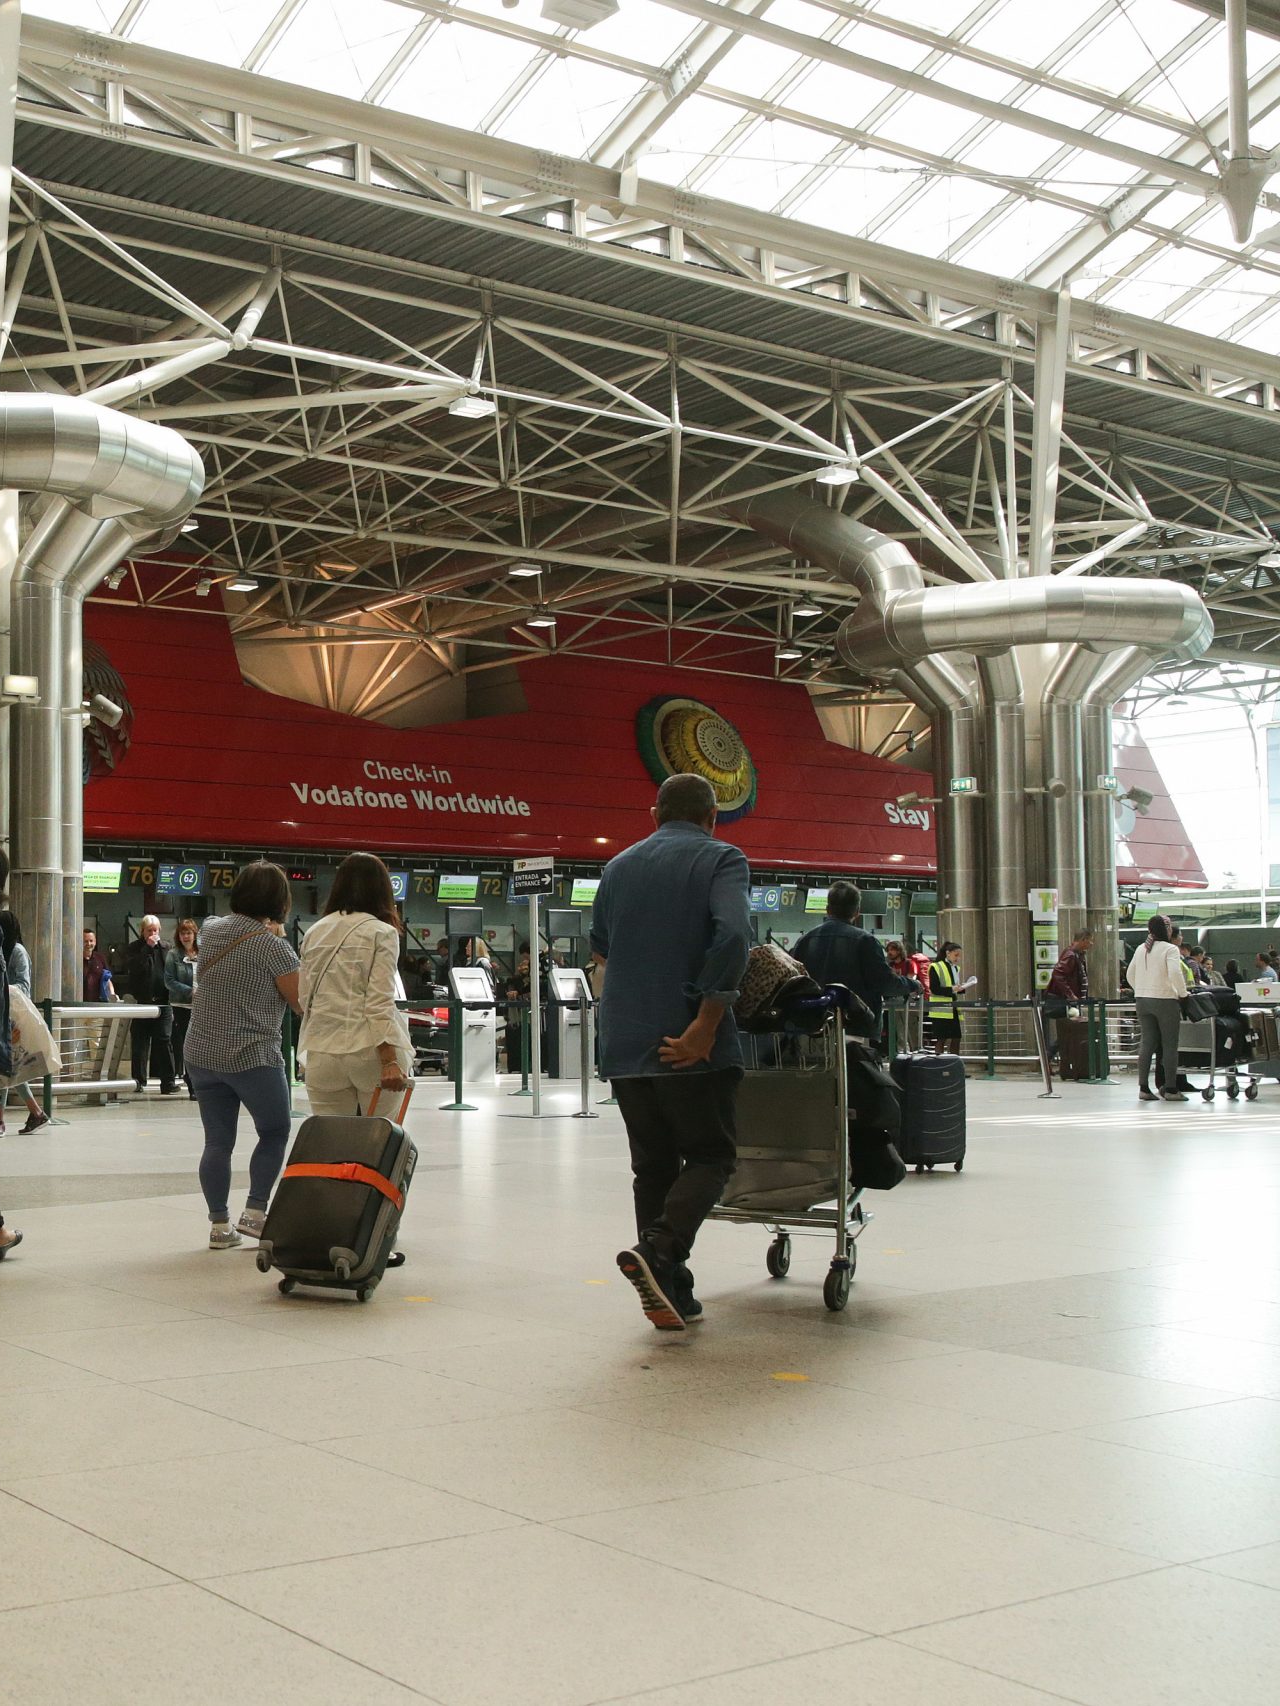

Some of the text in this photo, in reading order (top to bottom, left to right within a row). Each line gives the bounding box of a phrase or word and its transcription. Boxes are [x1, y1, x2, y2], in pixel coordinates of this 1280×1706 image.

[363, 760, 453, 784] Check-in
[290, 782, 531, 817] Vodafone Worldwide
[884, 802, 930, 831] Stay
[129, 866, 153, 885] 76
[183, 873, 194, 883] 62
[210, 868, 233, 887] 75
[515, 873, 539, 882] ENTRADA
[515, 880, 541, 888] ENTRANCE
[414, 876, 434, 894] 73
[481, 878, 501, 896] 72
[781, 890, 797, 906] 67
[887, 895, 901, 910] 65
